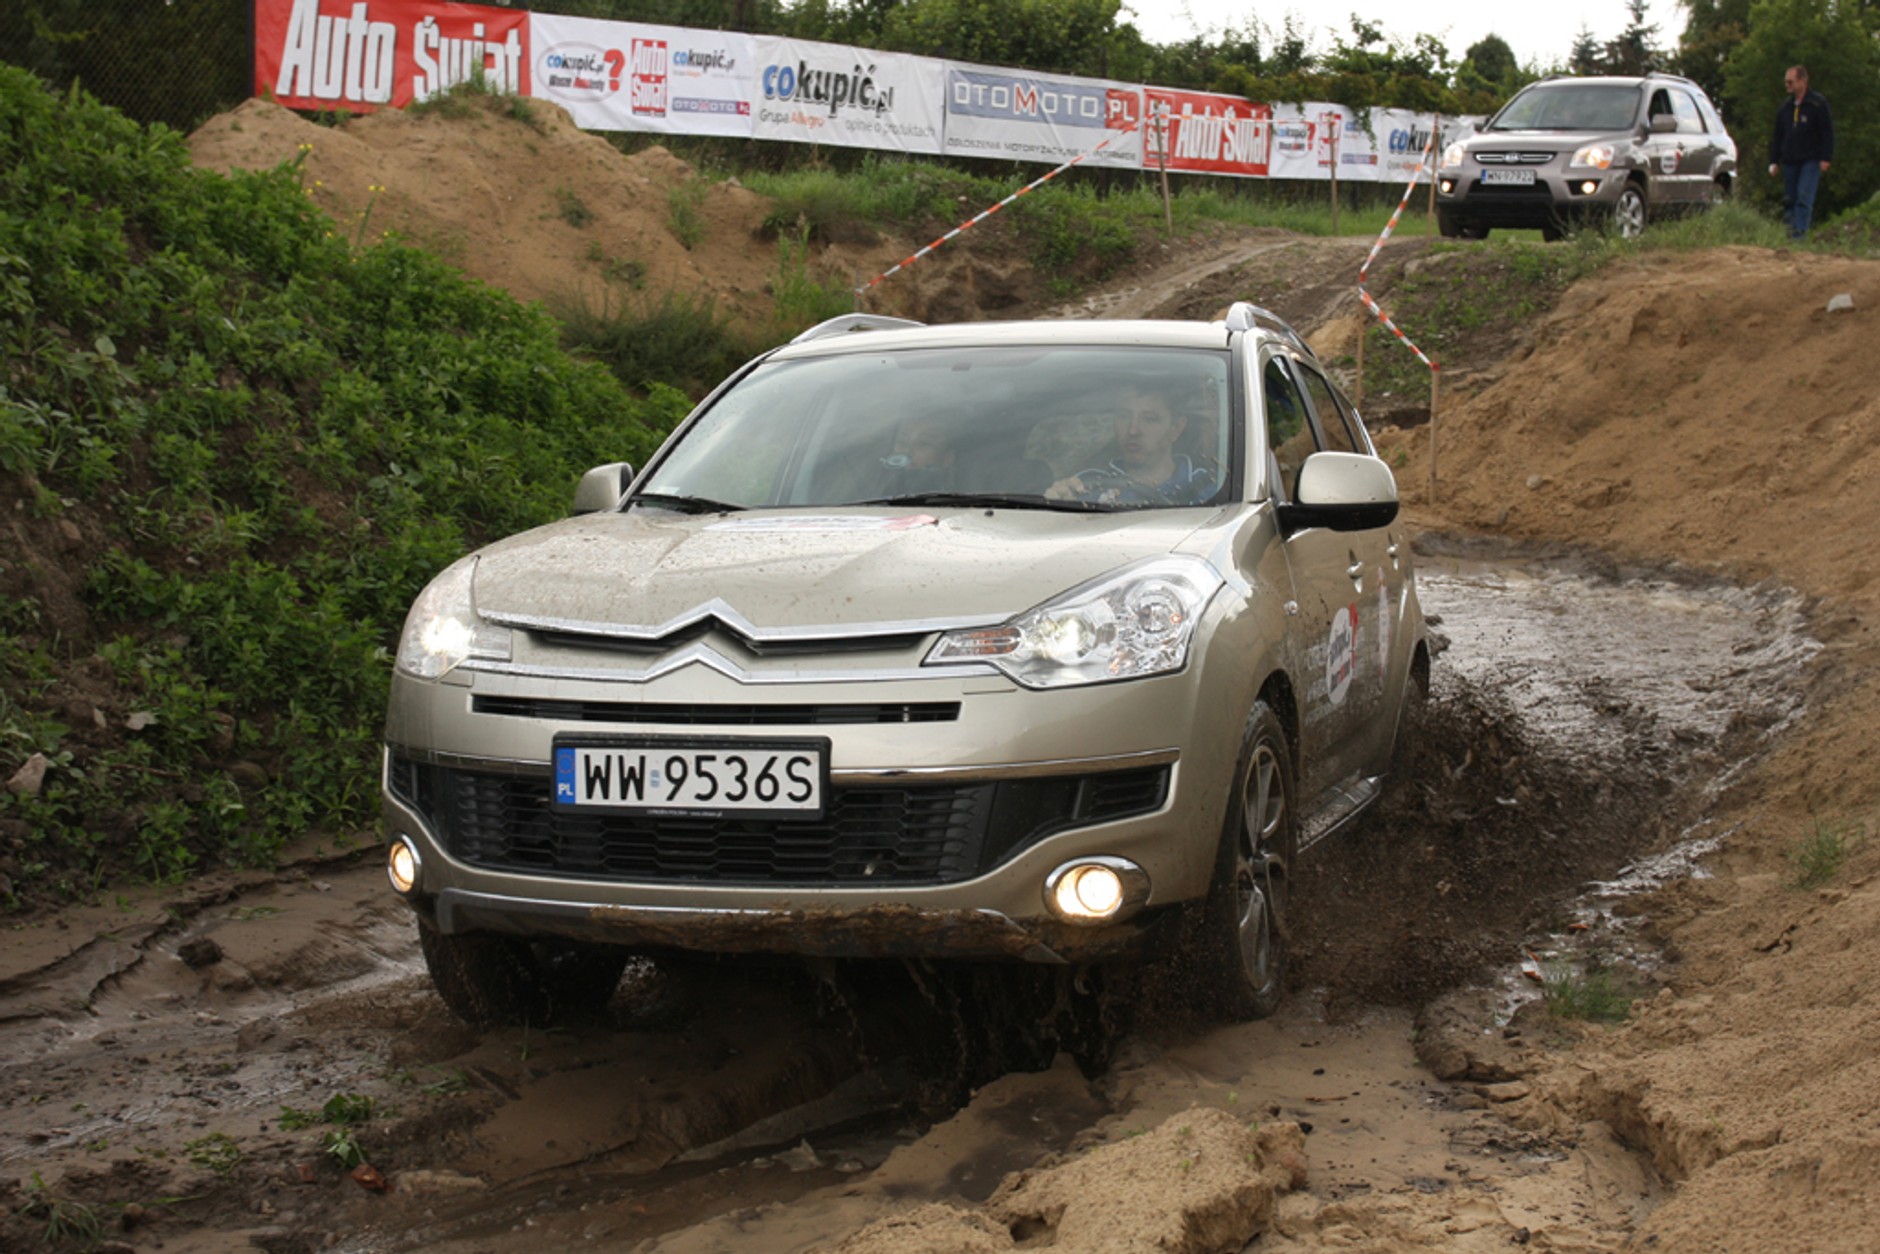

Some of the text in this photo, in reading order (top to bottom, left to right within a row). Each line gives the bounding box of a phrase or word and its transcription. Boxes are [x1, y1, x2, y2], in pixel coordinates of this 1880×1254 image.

[275, 0, 522, 104] Auto Świat
[762, 60, 894, 118] cokupić.pl
[953, 81, 1136, 122] OTOMOTO.PL
[759, 108, 789, 126] Grupa
[1174, 102, 1223, 161] Auto
[1223, 105, 1269, 165] Świat
[558, 783, 574, 796] PL
[584, 754, 813, 802] WW 9536S
